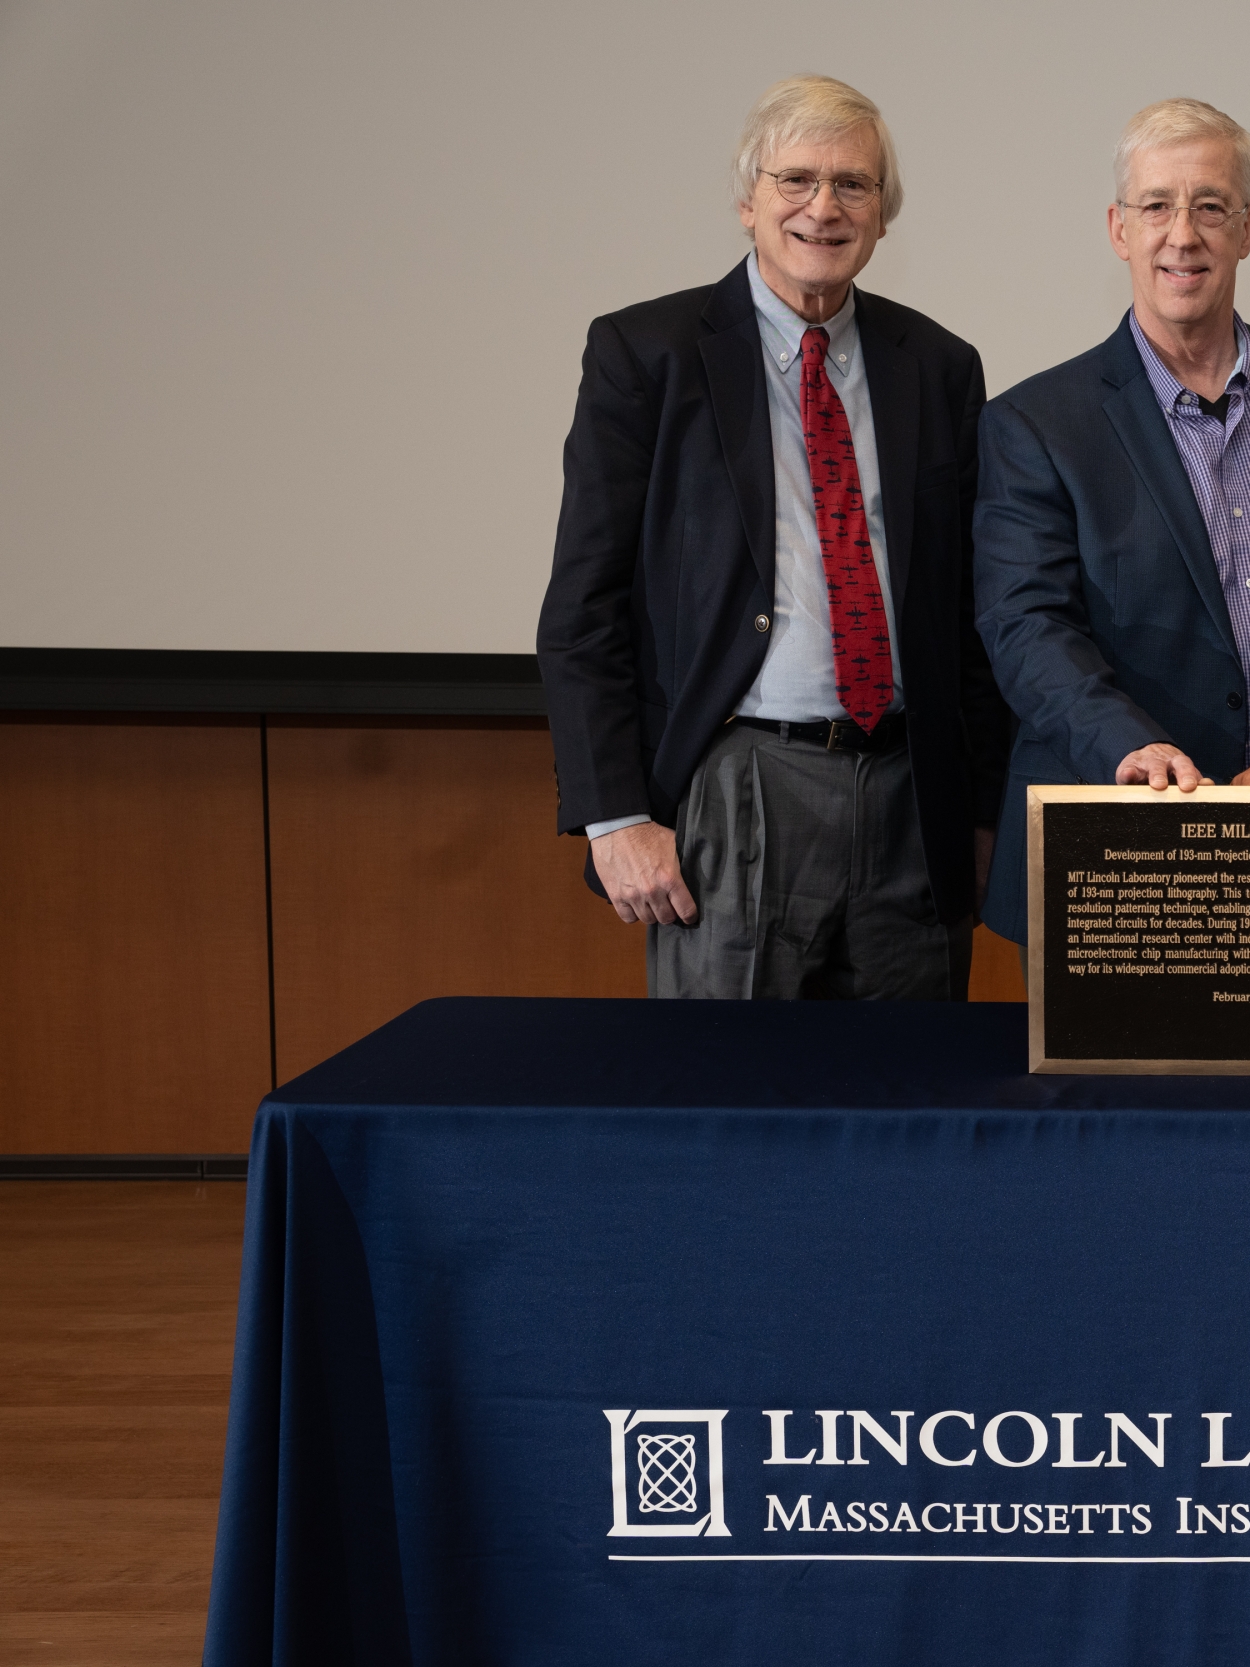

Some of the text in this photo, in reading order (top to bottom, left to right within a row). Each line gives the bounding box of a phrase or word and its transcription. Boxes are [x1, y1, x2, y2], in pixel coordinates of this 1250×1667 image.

[1181, 823, 1216, 838] IEEE
[1104, 849, 1164, 862] Development
[1167, 849, 1177, 860] of
[1179, 849, 1212, 860] 193-nm
[1068, 871, 1085, 882] MIT
[1087, 871, 1120, 883] Lincoln
[1122, 872, 1171, 885] Laboratory
[1173, 872, 1218, 885] pioneered
[1220, 872, 1234, 883] the
[1067, 887, 1078, 898] of
[1082, 887, 1114, 898] 193-nm
[1118, 887, 1163, 900] projection
[1167, 887, 1218, 901] lithography.
[1222, 887, 1242, 898] This
[1067, 902, 1112, 913] resolution
[1115, 902, 1160, 916] patterning
[1163, 902, 1209, 916] technique,
[1212, 902, 1250, 916] enabling
[1067, 917, 1112, 931] integrated
[1115, 917, 1147, 928] circuits
[1150, 917, 1163, 928] for
[1165, 917, 1204, 928] decades.
[1207, 917, 1237, 931] During
[1067, 935, 1079, 943] an
[1082, 932, 1138, 943] international
[1142, 933, 1180, 943] research
[1184, 934, 1212, 943] center
[1216, 933, 1235, 944] with
[1068, 947, 1137, 958] microelectronic
[1142, 948, 1161, 961] chip
[1165, 948, 1228, 961] manufacturing
[1068, 965, 1086, 976] way
[1088, 962, 1100, 973] for
[1102, 963, 1113, 973] its
[1115, 963, 1164, 976] widespread
[1167, 963, 1217, 974] commercial
[762, 1410, 1172, 1467] LINCOLN
